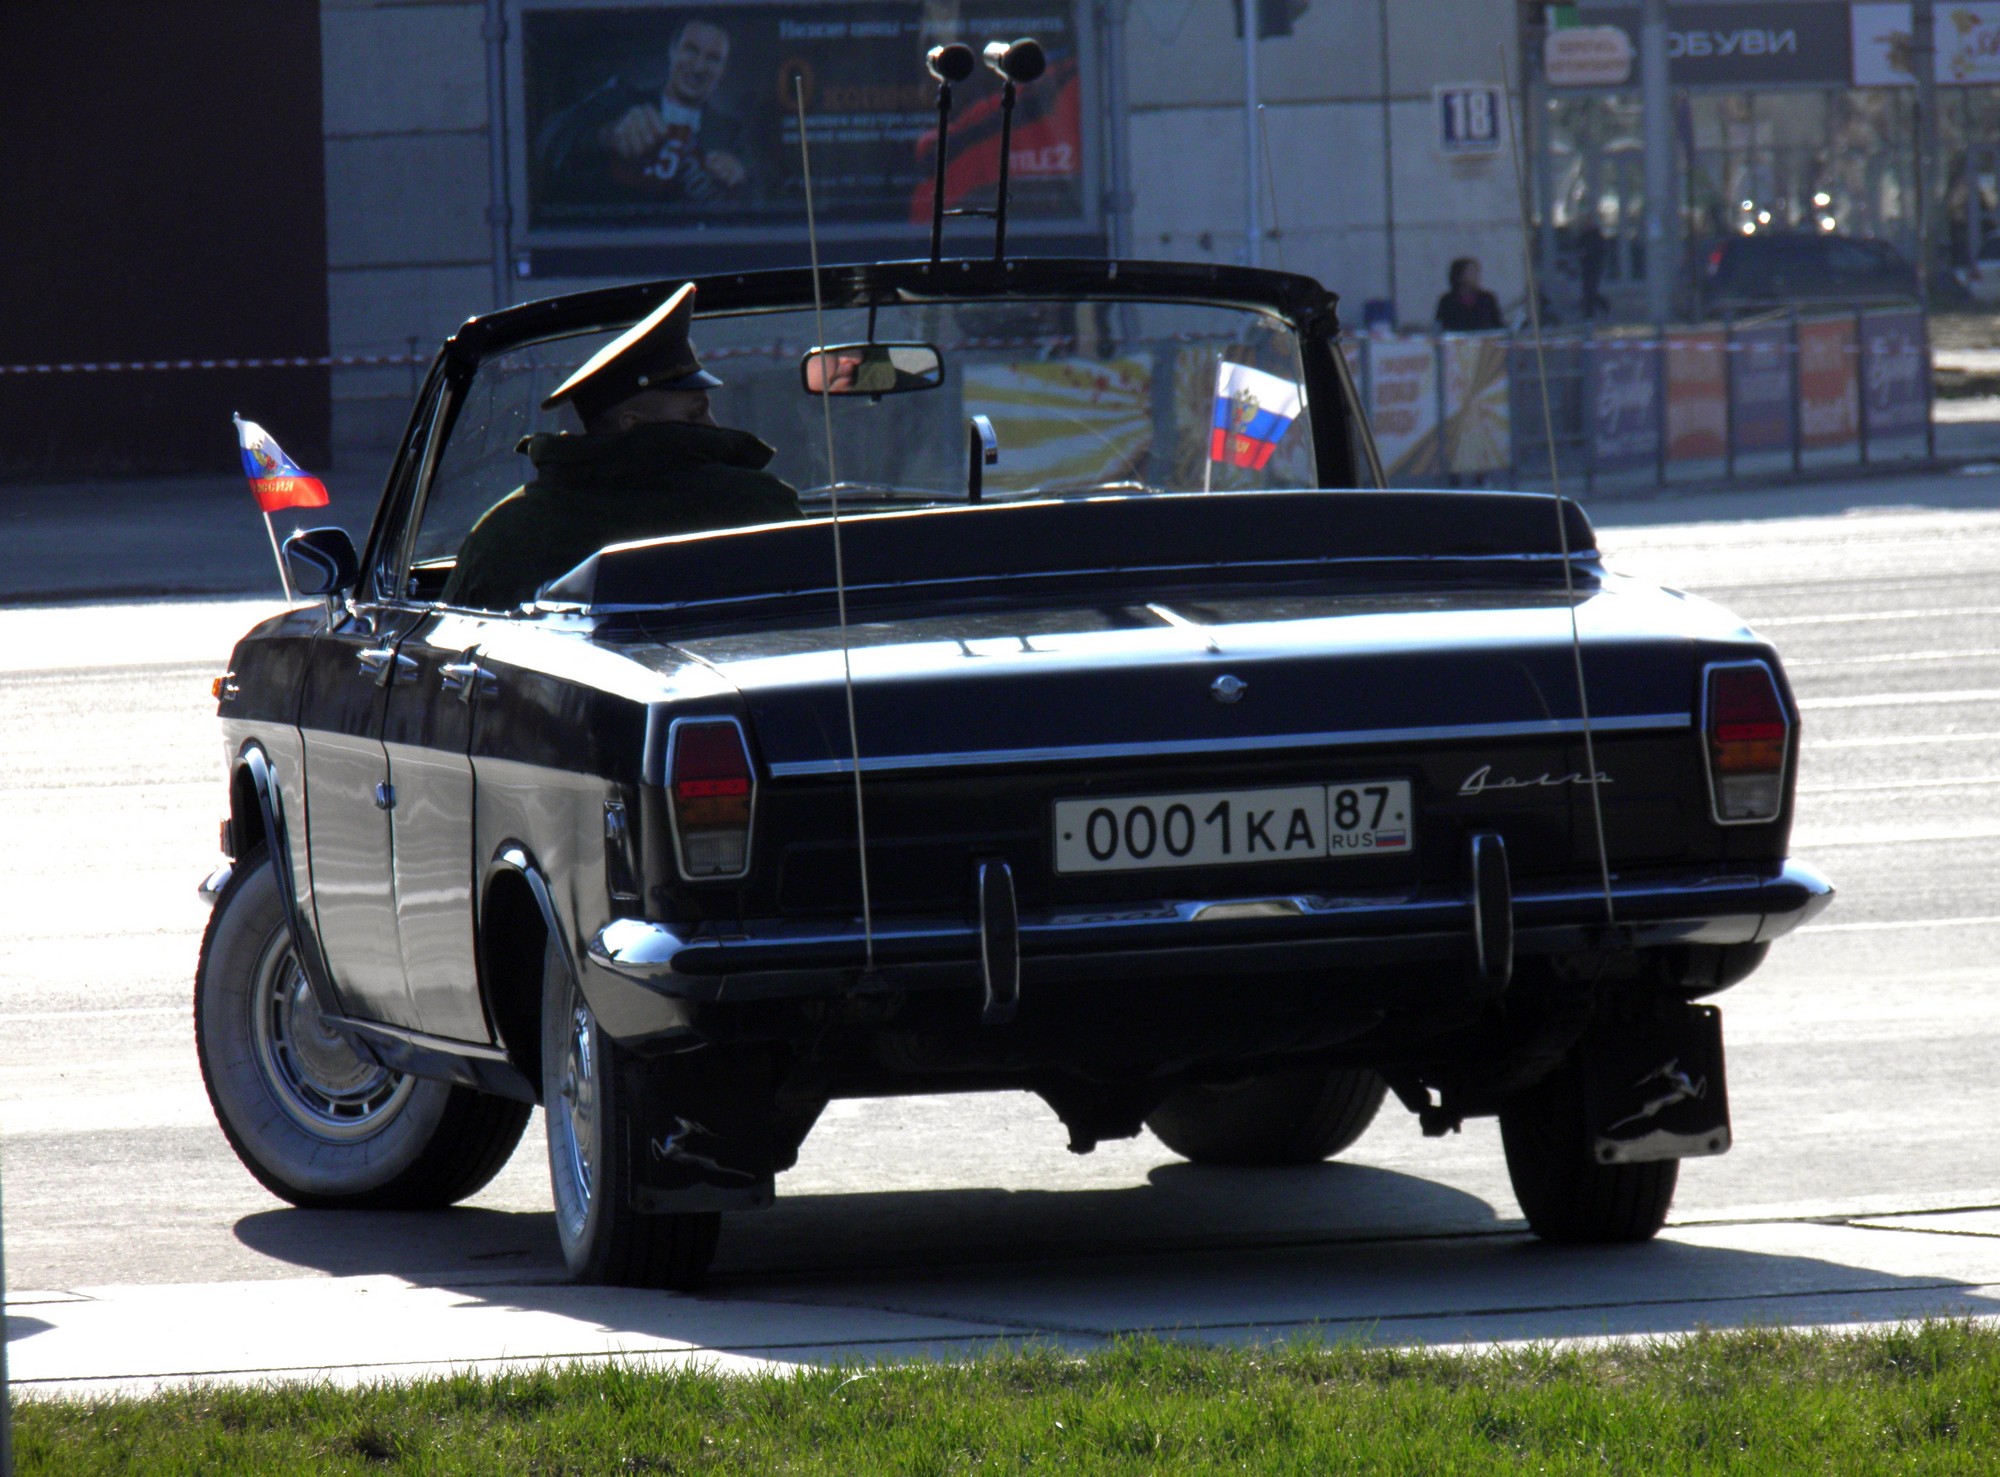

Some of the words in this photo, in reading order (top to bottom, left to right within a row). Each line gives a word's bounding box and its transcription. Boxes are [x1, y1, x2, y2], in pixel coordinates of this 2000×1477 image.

[1450, 92, 1491, 139] 18
[1334, 786, 1390, 830] 87
[1332, 832, 1374, 849] RUS
